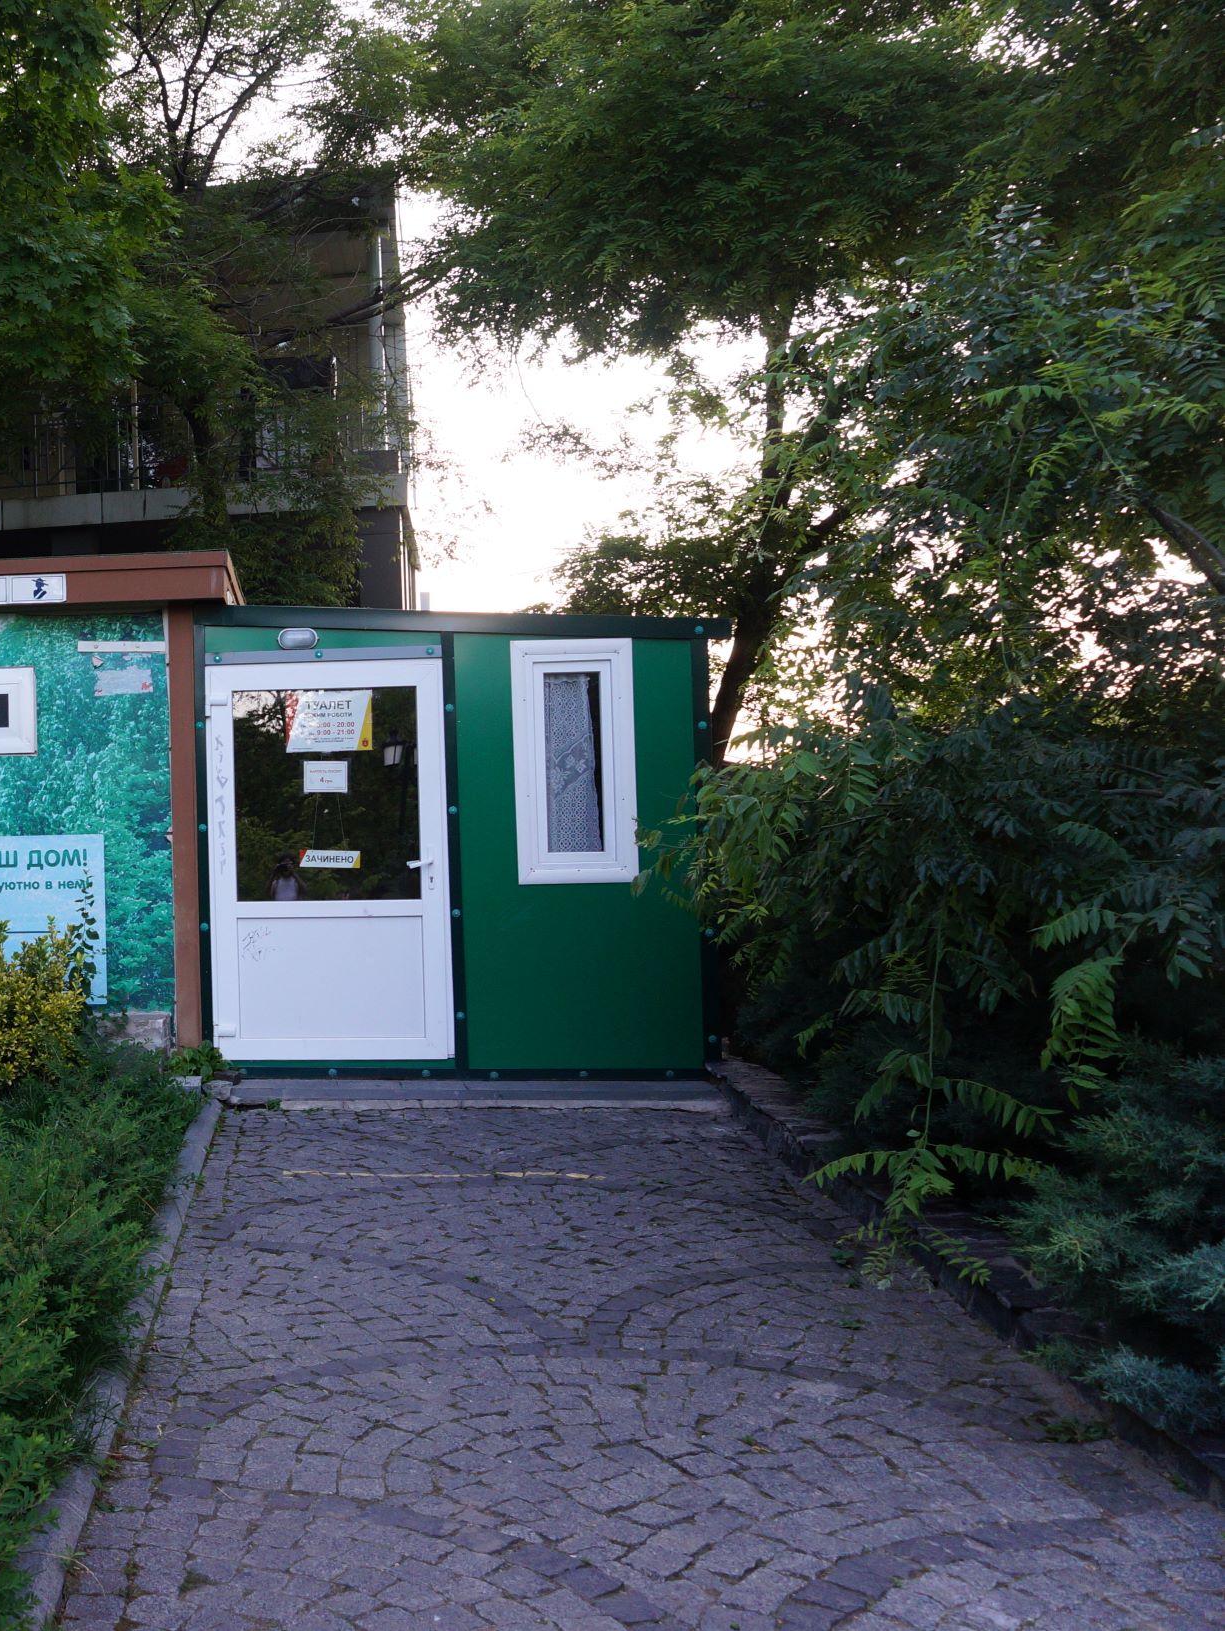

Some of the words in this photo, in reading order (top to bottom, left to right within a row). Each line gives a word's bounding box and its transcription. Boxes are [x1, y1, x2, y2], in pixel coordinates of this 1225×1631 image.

[304, 699, 352, 710] ТУАЛЕТ
[27, 848, 87, 870] ДОМ!
[305, 854, 354, 864] ЗАЧИНЕНО
[45, 881, 53, 890] в
